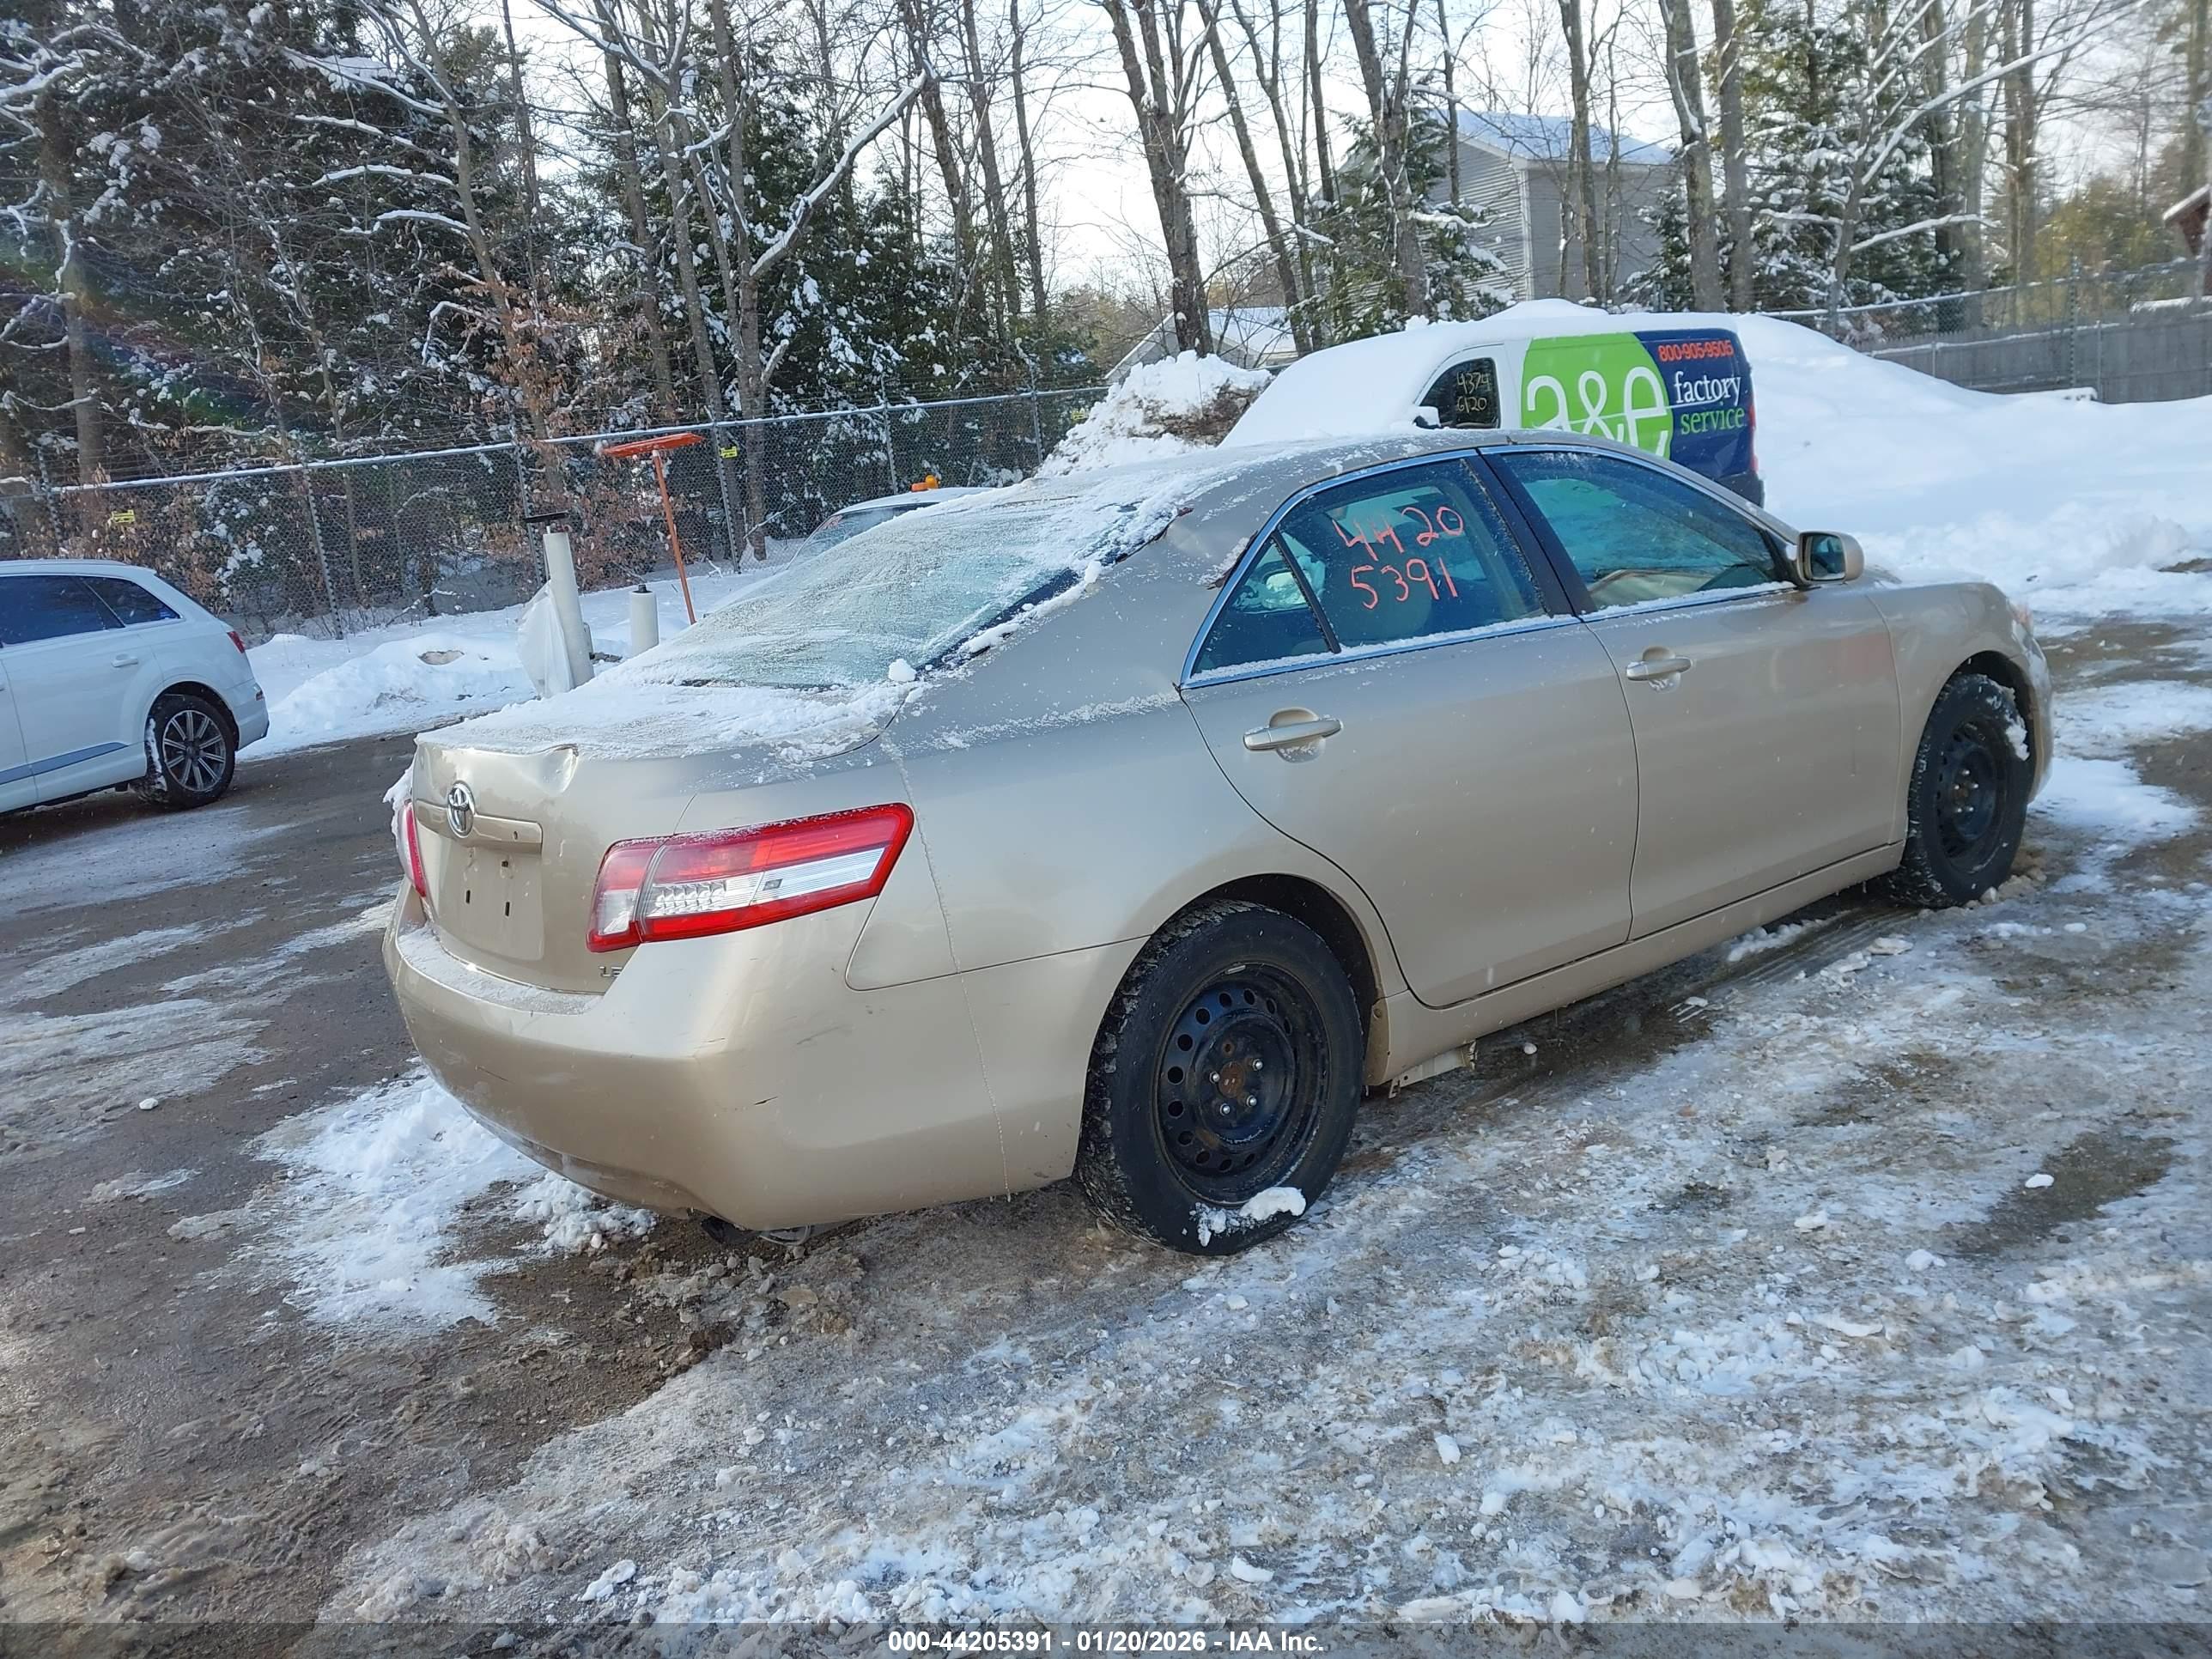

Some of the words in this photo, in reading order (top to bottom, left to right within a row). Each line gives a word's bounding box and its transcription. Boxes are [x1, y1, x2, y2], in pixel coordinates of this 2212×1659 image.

[1456, 372, 1492, 394] 4374
[1674, 370, 1741, 407] factory
[1456, 396, 1487, 413] 6120
[1680, 407, 1746, 435] service
[1350, 556, 1459, 611] 5391
